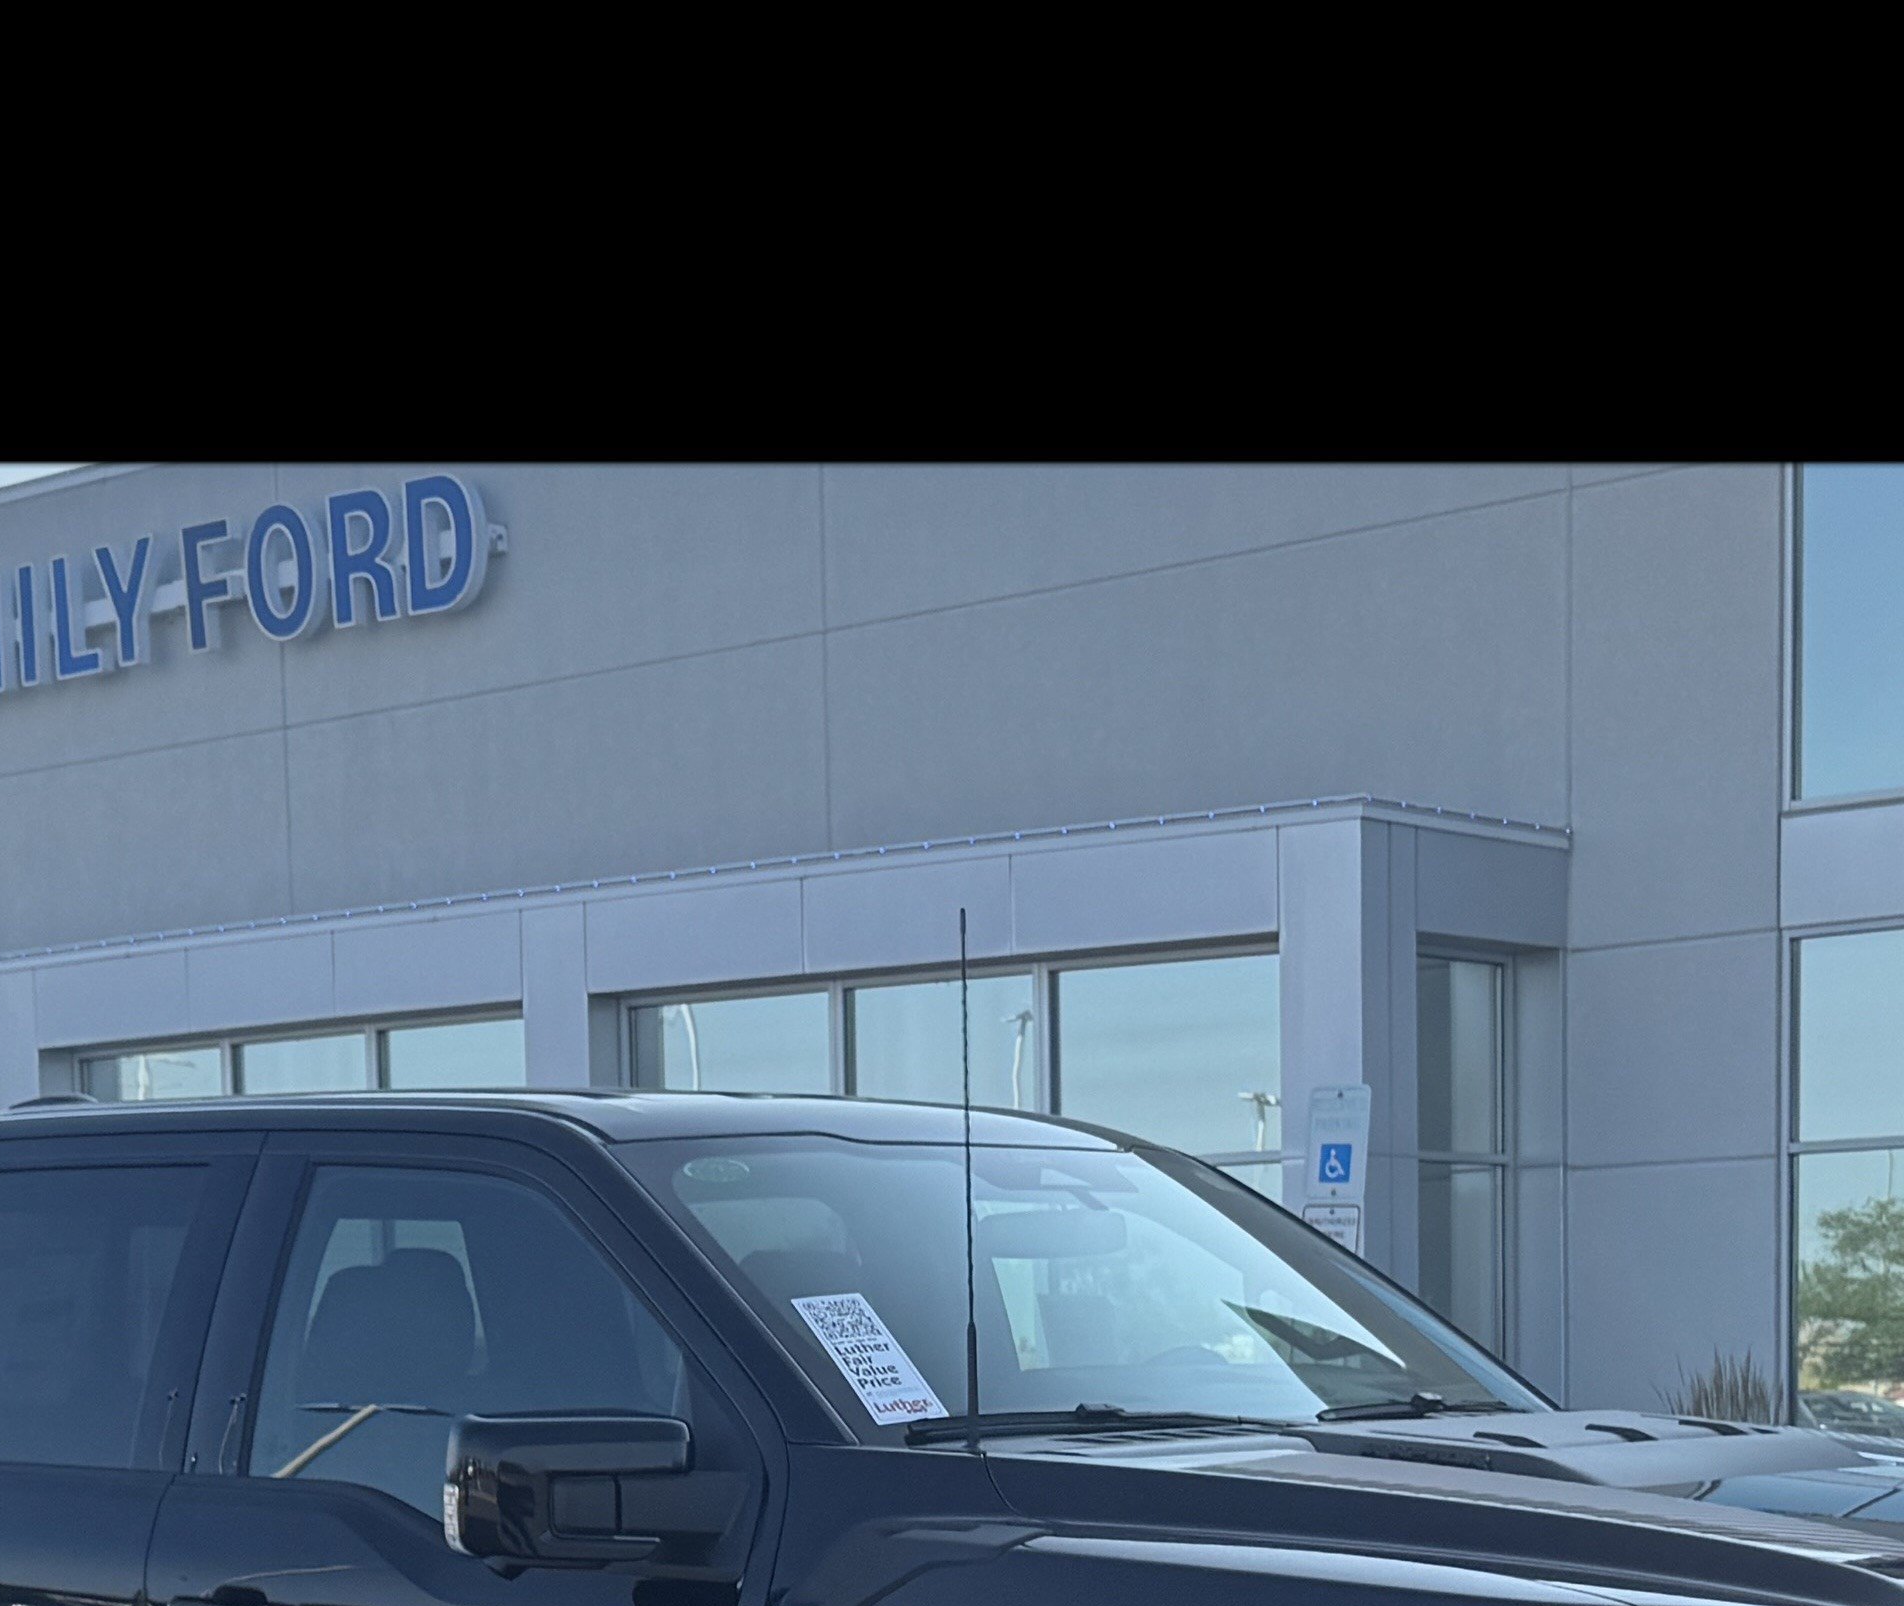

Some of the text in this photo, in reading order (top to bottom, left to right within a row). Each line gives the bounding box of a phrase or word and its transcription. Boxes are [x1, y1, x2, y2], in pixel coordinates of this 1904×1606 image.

[182, 473, 488, 653] FORD
[834, 1343, 890, 1356] Luther
[842, 1355, 873, 1368] Fair
[848, 1365, 899, 1377] Value
[857, 1376, 903, 1390] Price
